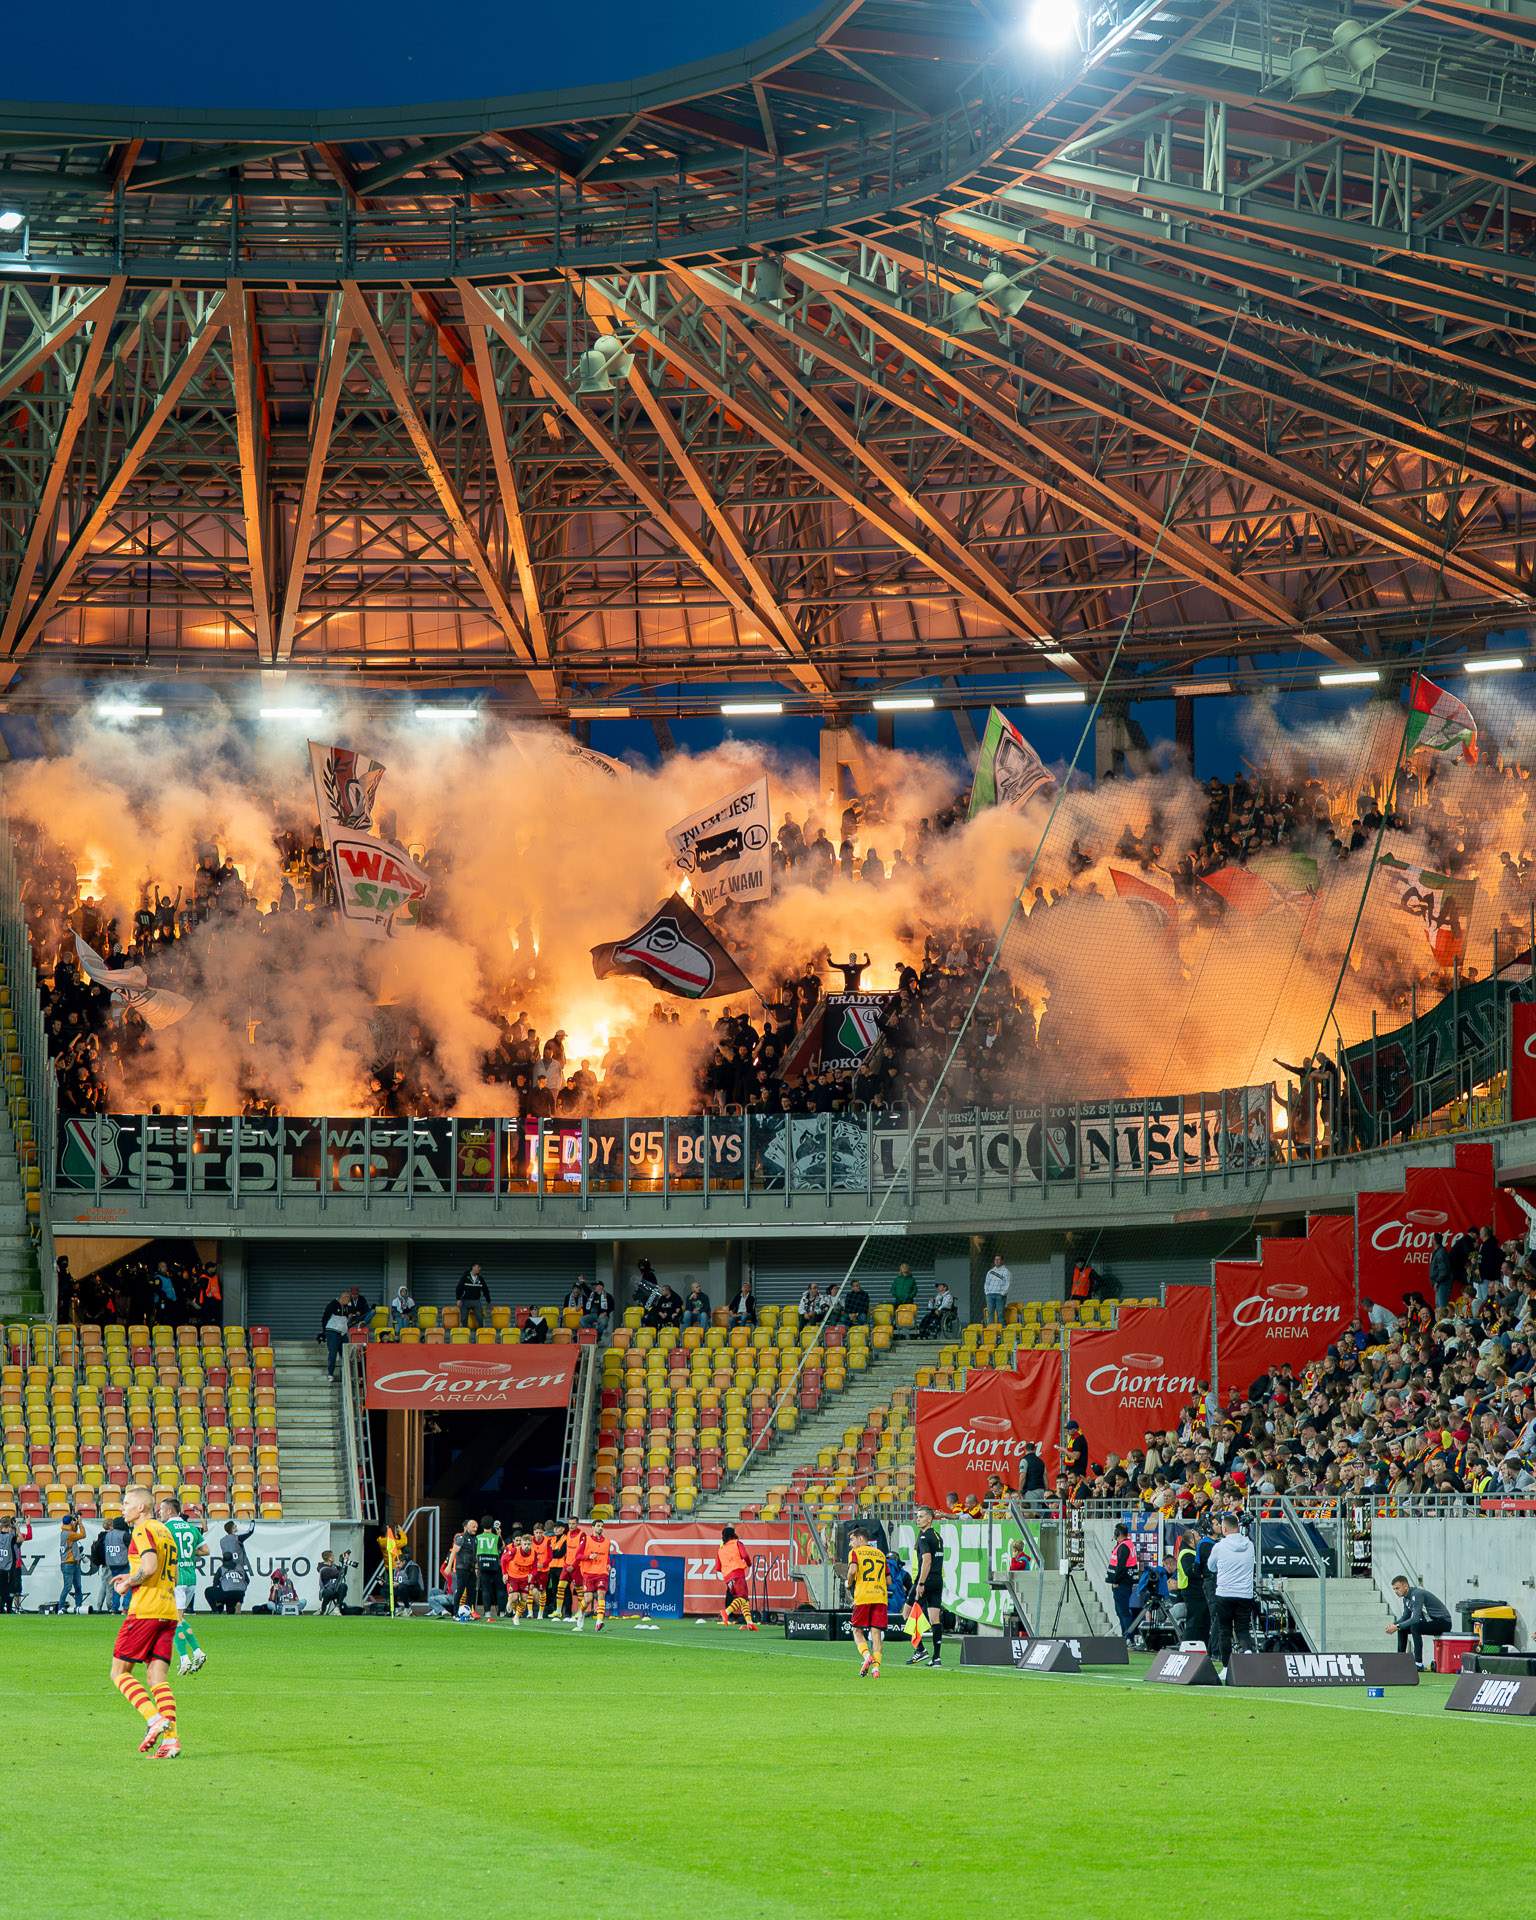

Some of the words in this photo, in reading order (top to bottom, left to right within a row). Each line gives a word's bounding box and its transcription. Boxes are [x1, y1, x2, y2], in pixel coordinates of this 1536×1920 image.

[729, 792, 755, 818] JEST
[729, 870, 763, 892] WAMI
[1015, 1108, 1042, 1120] ULIC
[1050, 1107, 1065, 1117] TO
[137, 1124, 310, 1147] JESTEŚMY
[320, 1130, 438, 1152] WASZĄ
[525, 1134, 615, 1164] TEDDY
[629, 1132, 664, 1164] 95
[677, 1134, 742, 1164] BOYS
[128, 1152, 445, 1191] STOLICA
[1371, 1220, 1464, 1251] Chorte
[1404, 1252, 1432, 1264] ARE
[1233, 1295, 1340, 1327] Chorten
[1265, 1326, 1309, 1338] ARENA
[373, 1369, 566, 1393] Chorten
[1086, 1363, 1196, 1396] Chorten
[430, 1394, 508, 1402] ARENA
[1119, 1396, 1163, 1409] ARENA
[966, 1459, 1010, 1472] ARENA
[175, 1531, 194, 1558] 13
[479, 1538, 495, 1549] TV
[863, 1559, 885, 1582] 27
[1254, 1556, 1286, 1565] IVE
[1290, 1556, 1330, 1566] PAK
[627, 1601, 650, 1610] Bank
[651, 1602, 676, 1612] Polski
[797, 1623, 811, 1631] LIVE
[811, 1623, 827, 1631] PARK
[1294, 1654, 1366, 1676] Witt
